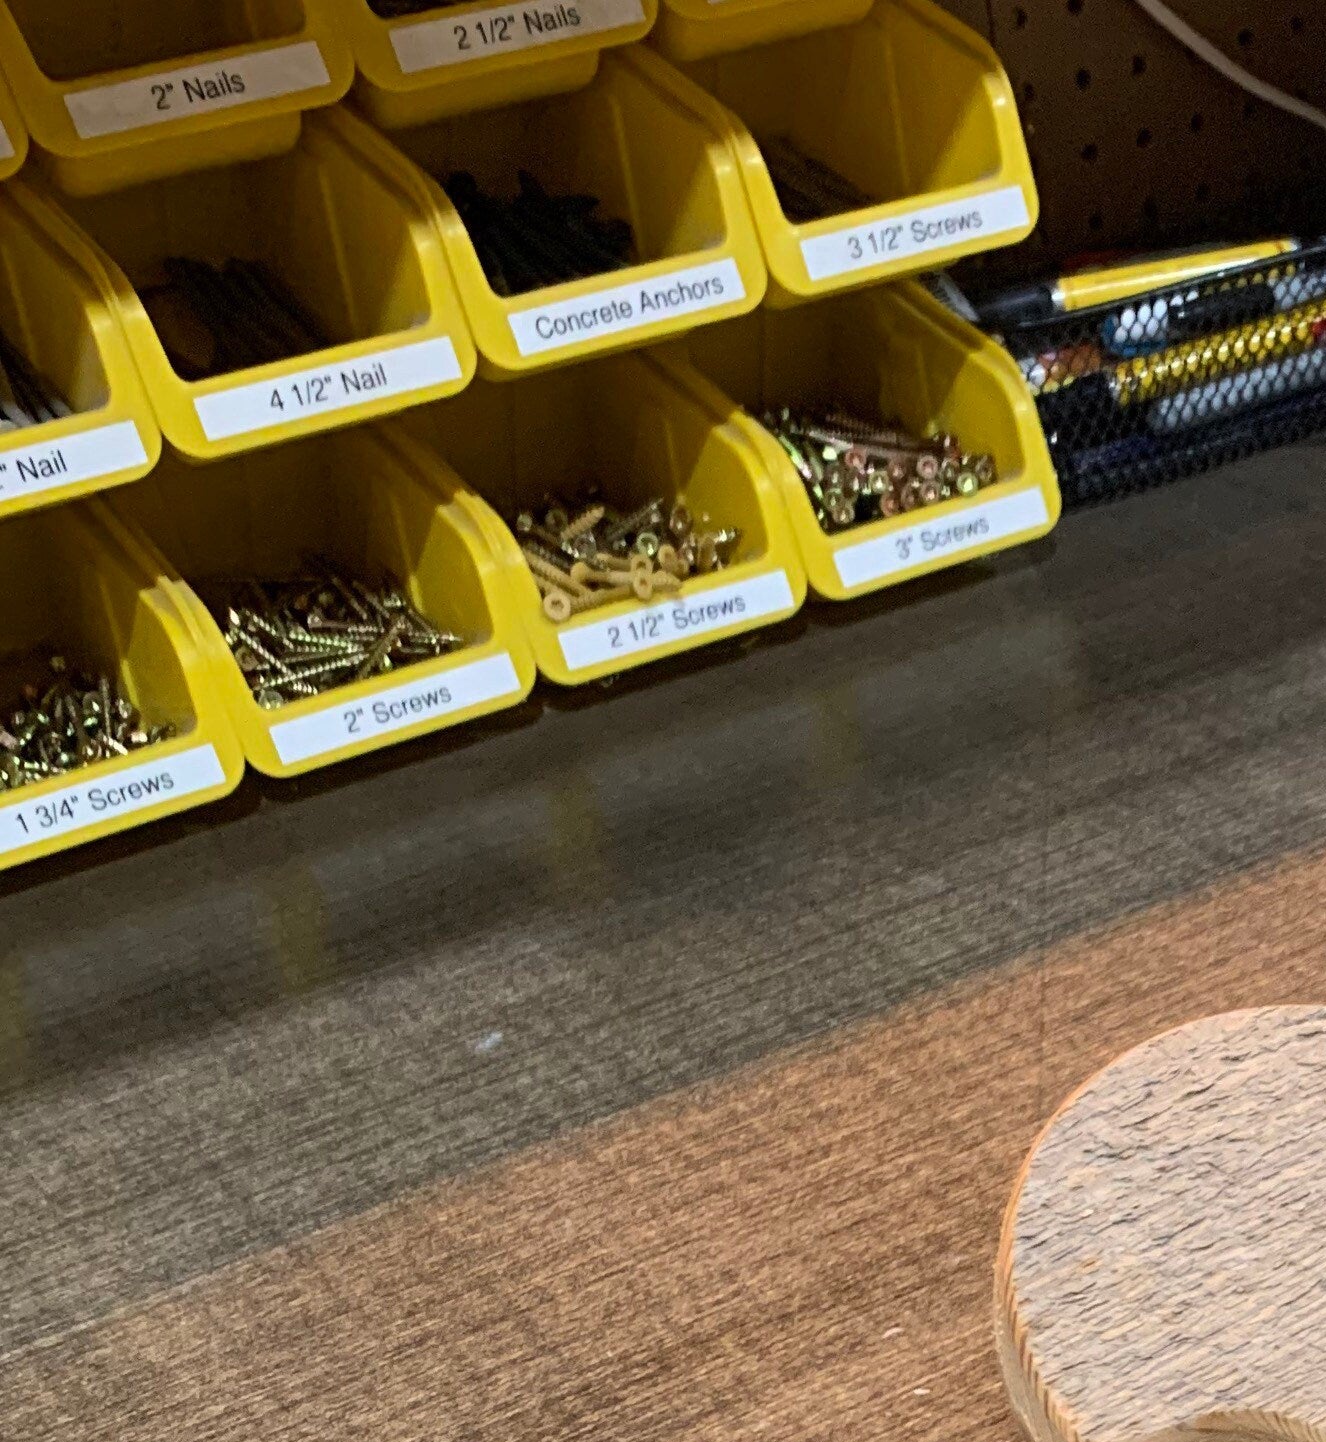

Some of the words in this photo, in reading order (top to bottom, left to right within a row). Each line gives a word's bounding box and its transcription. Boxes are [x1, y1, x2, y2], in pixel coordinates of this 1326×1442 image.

[453, 25, 472, 50] 2
[475, 15, 516, 45] 1/2"
[522, 4, 582, 35] Nails
[150, 82, 175, 111] 2"
[182, 70, 246, 103] Nails
[847, 236, 863, 259] 3
[867, 224, 904, 254] 1/2"
[910, 210, 984, 243] Screws
[535, 301, 633, 340] Concrete
[638, 276, 724, 315] Anchors
[270, 387, 285, 411] 4
[290, 374, 333, 406] 1/2"
[340, 361, 388, 395] Nail
[15, 449, 68, 483] Nail
[894, 532, 914, 561] 3"
[919, 516, 990, 553] Screws
[606, 625, 624, 649] 2
[627, 613, 665, 642] 1/2"
[671, 595, 747, 631] Screws
[343, 708, 364, 734] 2"
[371, 686, 453, 725] Screws
[15, 812, 30, 835] 1
[35, 794, 79, 829] 3/4"
[86, 771, 176, 813] Screws
